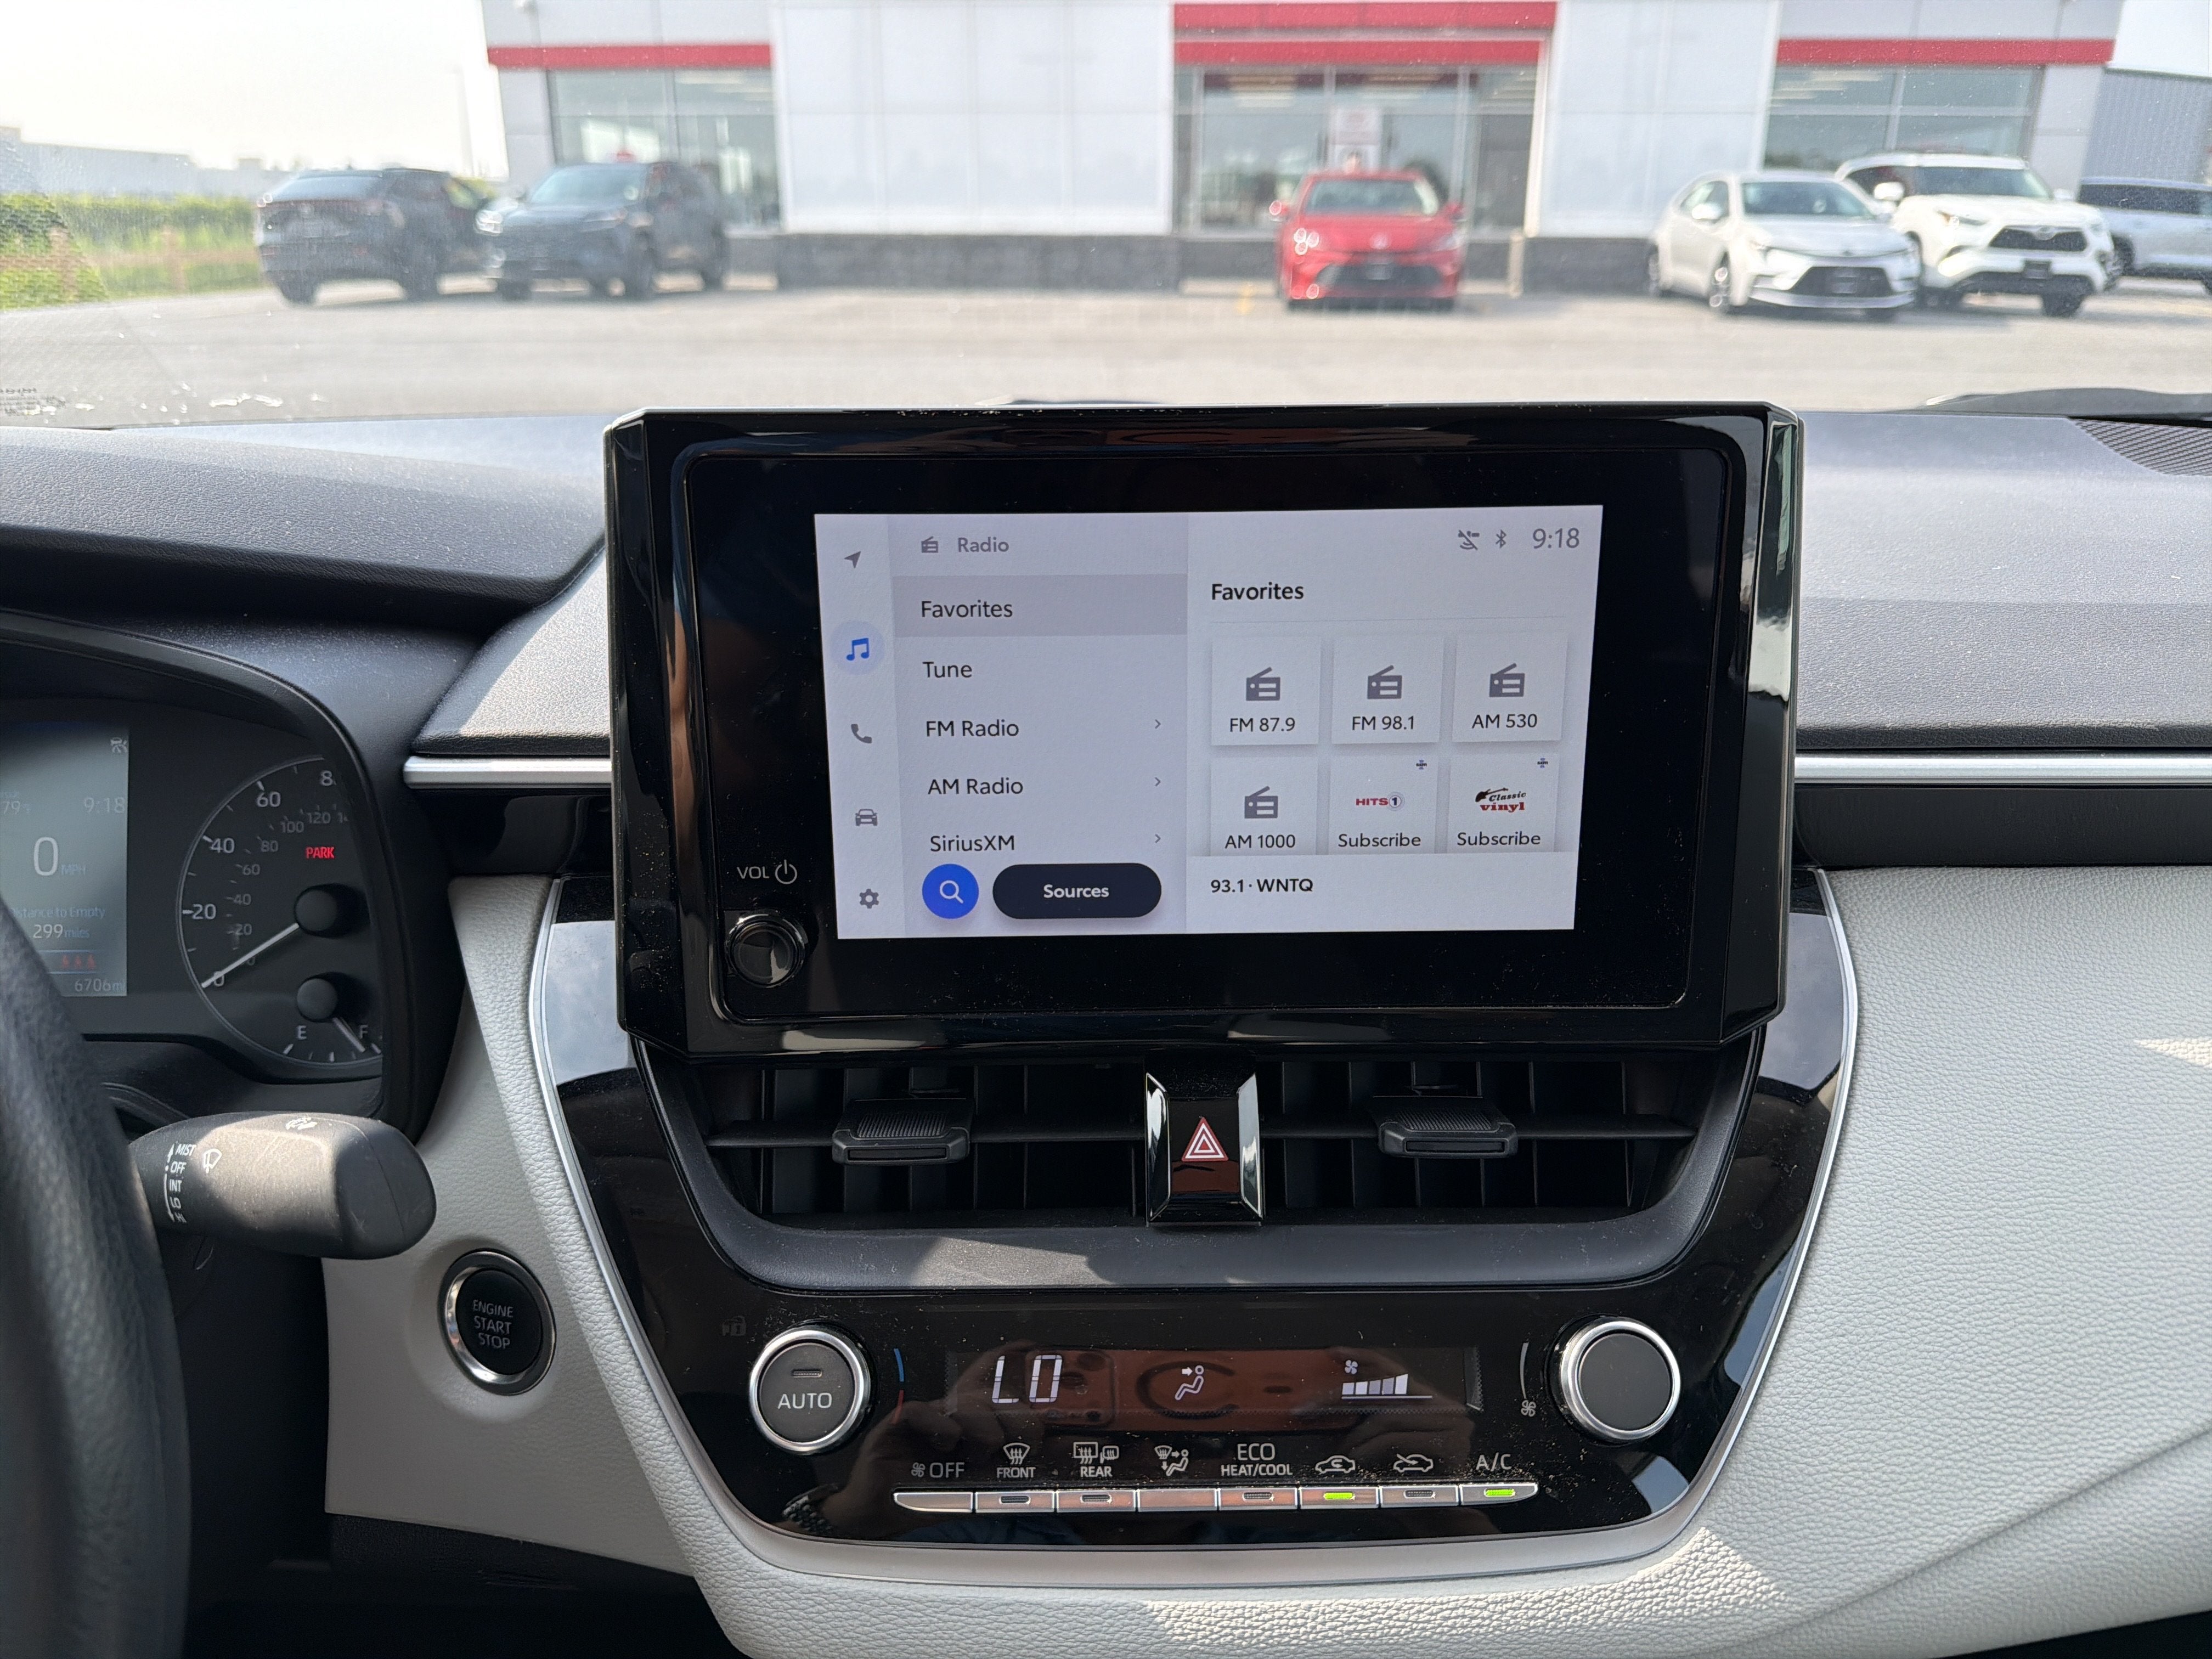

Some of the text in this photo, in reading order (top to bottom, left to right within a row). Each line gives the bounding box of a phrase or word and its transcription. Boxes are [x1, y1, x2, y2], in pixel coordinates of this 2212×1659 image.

[958, 537, 1010, 554] Radio
[1532, 527, 1580, 550] 9:18
[1212, 582, 1305, 601] Favorites
[921, 599, 1013, 619] Favorites
[922, 661, 973, 679] Tune
[926, 719, 1020, 737] FM Radio
[1230, 717, 1296, 733] FM 87.9
[1352, 715, 1415, 731] FM 98.1
[1471, 713, 1538, 729] AM 530
[928, 777, 1024, 795] AM Radio
[256, 791, 281, 808] 60
[1488, 791, 1526, 802] Classic
[84, 797, 126, 814] 9:18
[1480, 802, 1525, 812] vinyl
[308, 812, 331, 823] 120
[281, 821, 304, 833] 100
[211, 837, 235, 854] 40
[260, 840, 279, 852] 80
[930, 834, 1015, 853] SiriusXM
[1224, 834, 1297, 850] AM 1000
[1338, 832, 1421, 848] Subscribe
[1457, 831, 1542, 847] Subscribe
[33, 836, 59, 876] 0
[306, 847, 335, 859] PARK
[242, 864, 261, 876] 60
[736, 866, 770, 879] VOL
[1043, 883, 1110, 899] Sources
[1210, 878, 1314, 894] 93.1 WNTQ
[233, 893, 252, 905] 40
[192, 903, 217, 920] 20
[233, 923, 252, 935] 20
[297, 1025, 307, 1040] E
[359, 1024, 369, 1040] F
[175, 1143, 196, 1156] MIST
[170, 1161, 187, 1174] OFF
[169, 1179, 182, 1192] INT
[170, 1197, 182, 1209] LO
[174, 1211, 187, 1223] HI
[473, 1299, 514, 1318] ENGINE
[474, 1316, 512, 1335] START
[478, 1332, 511, 1350] STOP
[992, 1355, 1064, 1403] LO
[777, 1392, 833, 1410] AUTO
[1237, 1444, 1275, 1462] ECO
[1476, 1453, 1511, 1471] A/C
[929, 1462, 966, 1479] OFF
[996, 1467, 1036, 1479] FRONT
[1080, 1466, 1113, 1478] REAR
[1221, 1464, 1294, 1477] HEAT/COOL
